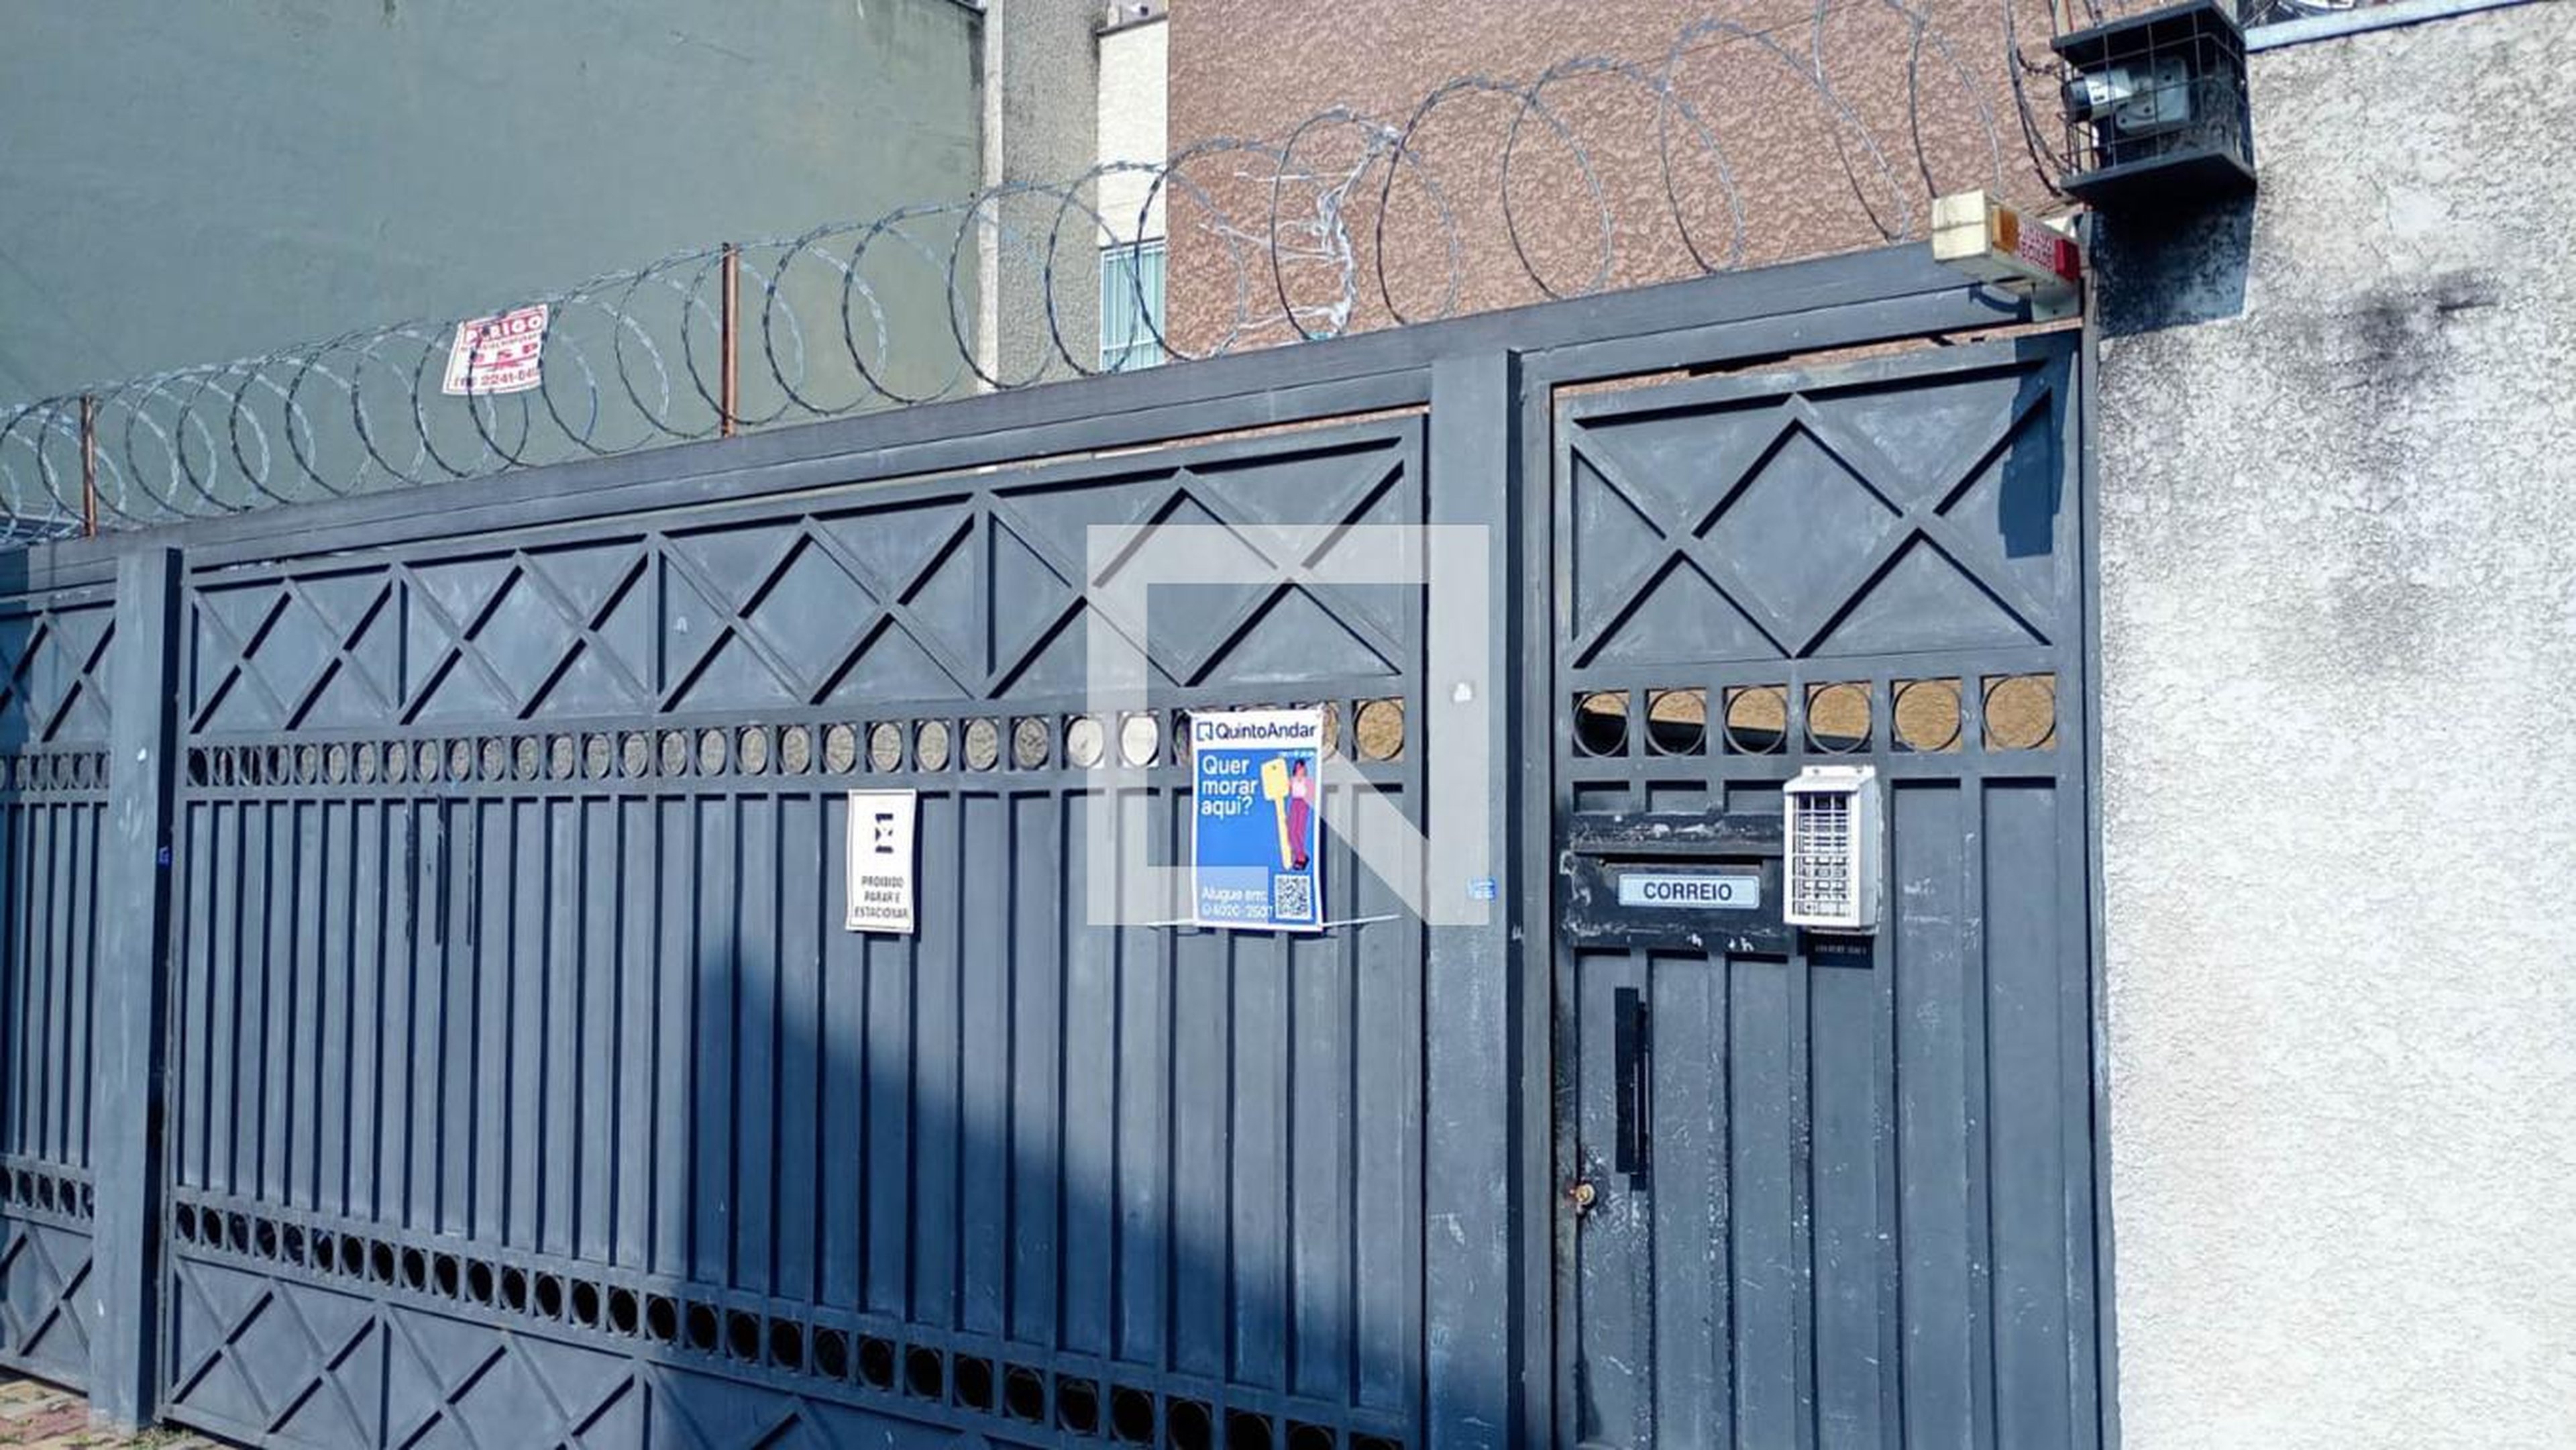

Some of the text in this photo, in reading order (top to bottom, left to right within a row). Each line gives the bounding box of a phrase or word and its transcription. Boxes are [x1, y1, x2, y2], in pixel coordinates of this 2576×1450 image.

[1215, 722, 1316, 739] QuintoAndar
[1202, 755, 1250, 775] Quer
[1201, 779, 1258, 796] morar
[1201, 796, 1253, 820] aqui?
[861, 875, 904, 889] PROIBIDO
[864, 891, 893, 903] PARAR
[1644, 882, 1732, 901] CORREIO
[855, 906, 908, 919] ESTACIONAR
